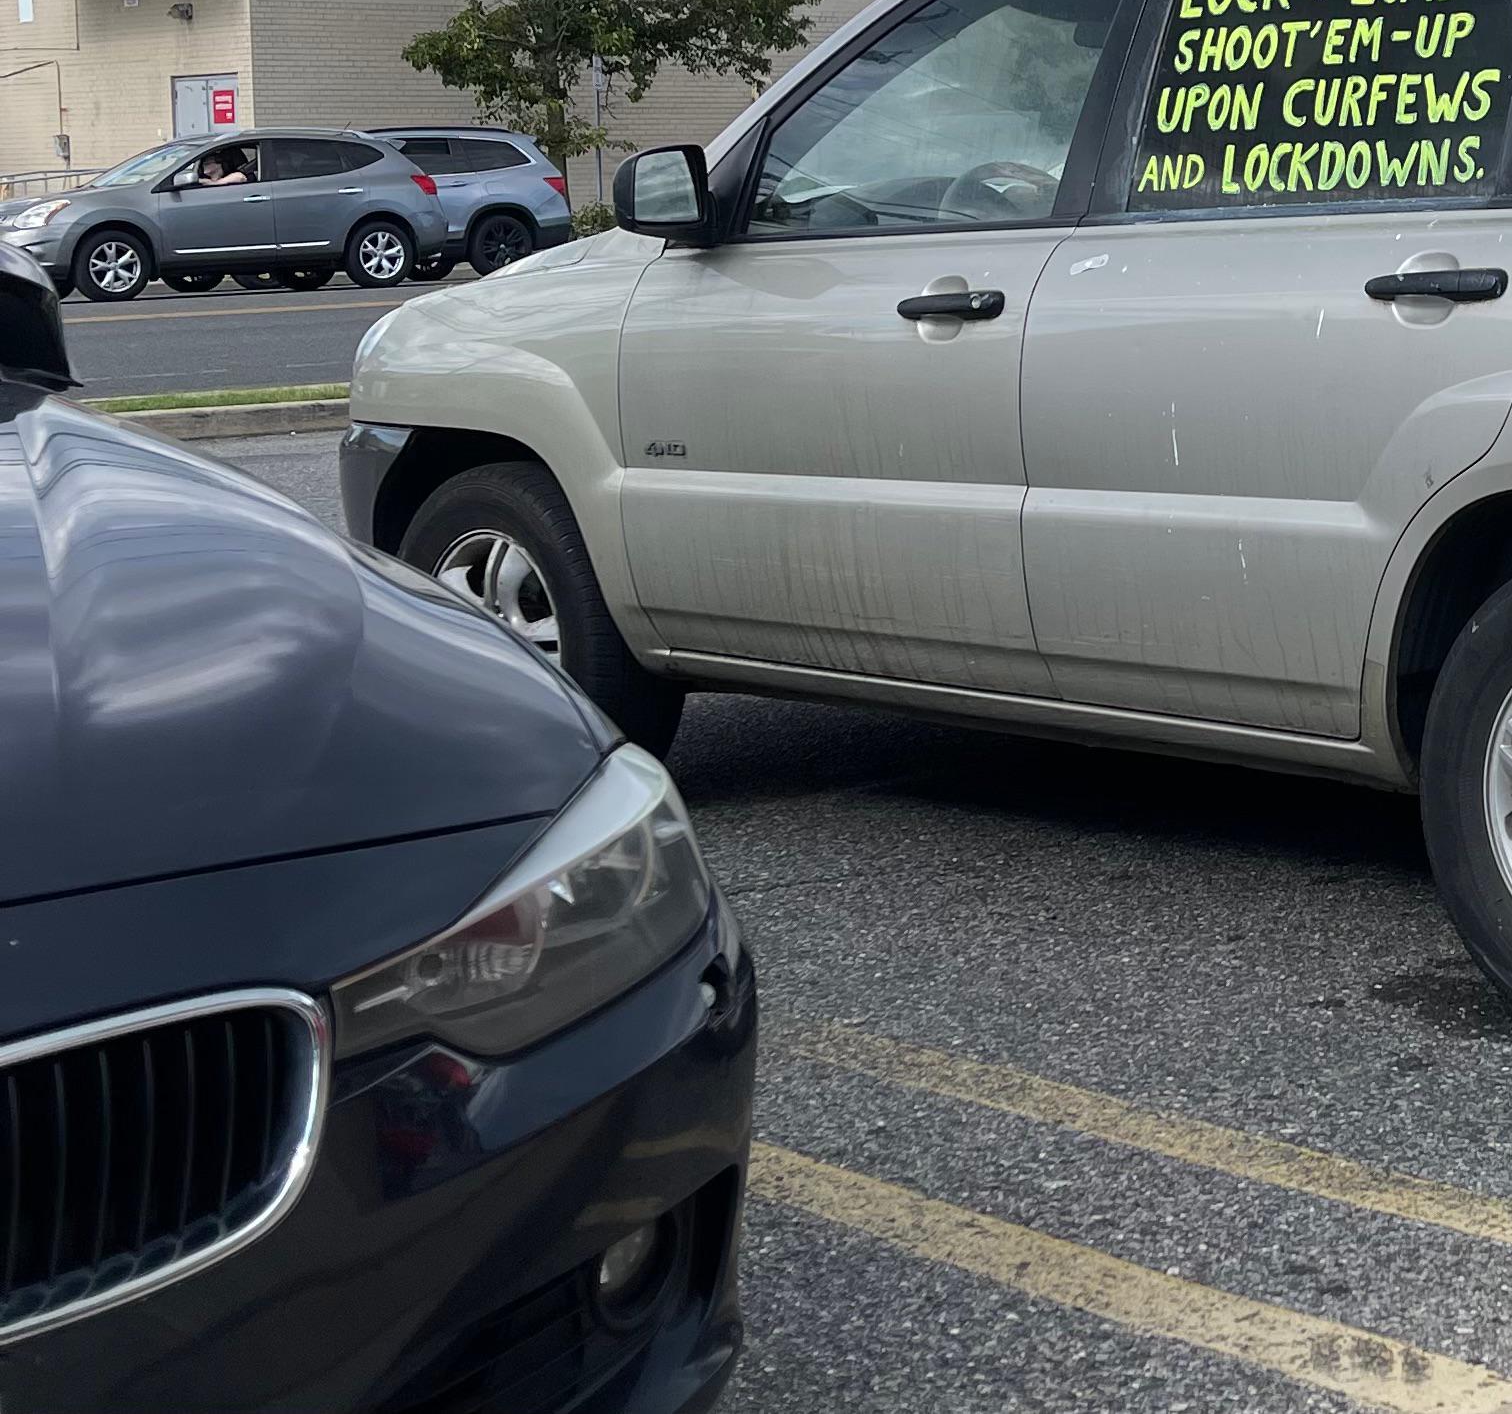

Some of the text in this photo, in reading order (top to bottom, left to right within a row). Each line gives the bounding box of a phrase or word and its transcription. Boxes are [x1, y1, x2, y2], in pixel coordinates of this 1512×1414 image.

[1156, 69, 1501, 133] UPON CURFEWS
[1138, 136, 1484, 195] AND LOCKDOWNS.
